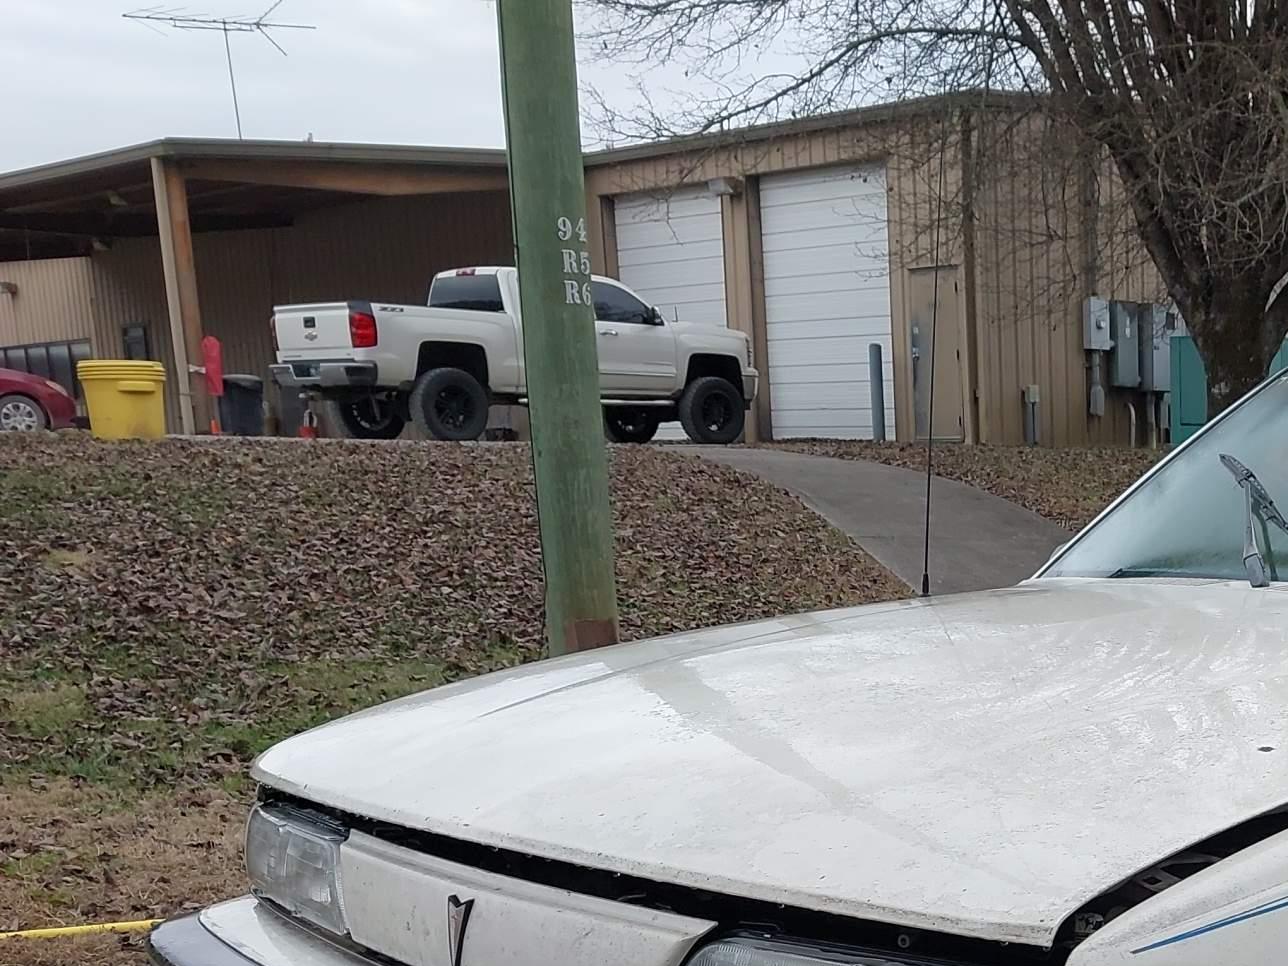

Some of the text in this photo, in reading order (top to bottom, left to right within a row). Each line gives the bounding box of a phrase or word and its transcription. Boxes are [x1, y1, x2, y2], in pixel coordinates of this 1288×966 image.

[557, 216, 588, 242] 94
[561, 249, 591, 275] R5
[563, 280, 592, 306] R6
